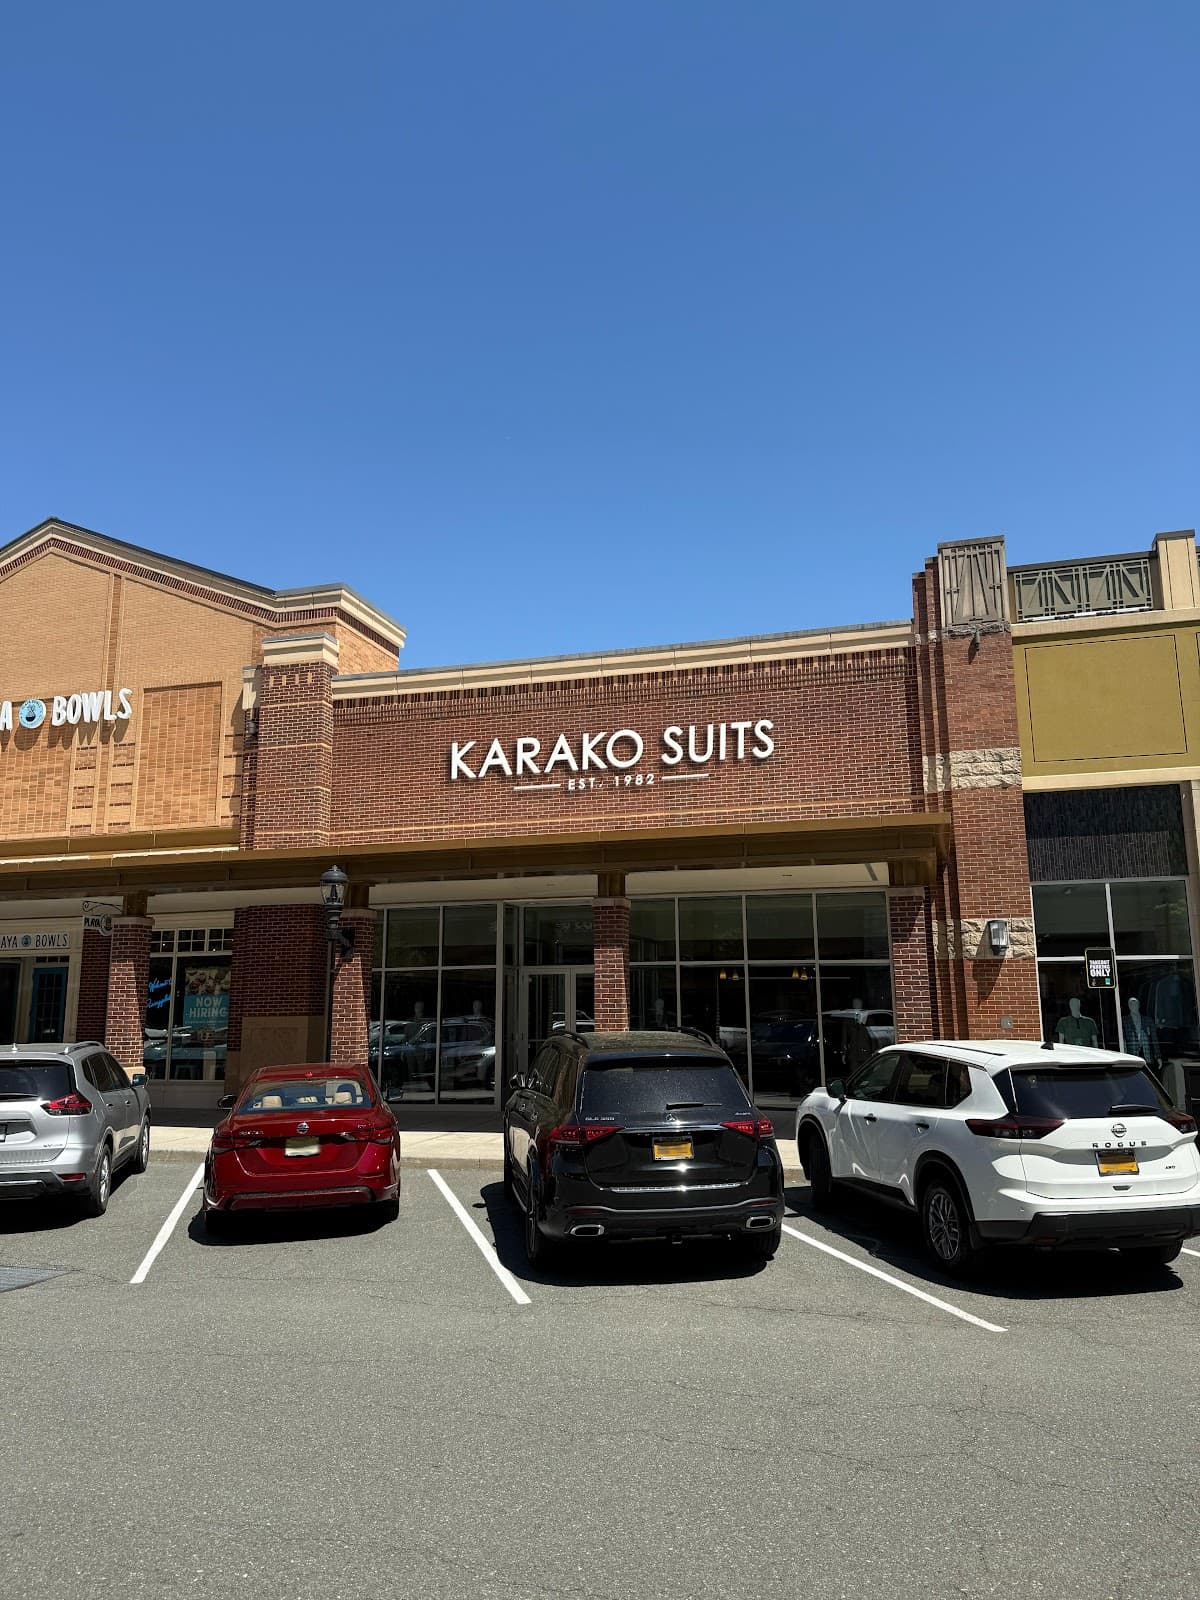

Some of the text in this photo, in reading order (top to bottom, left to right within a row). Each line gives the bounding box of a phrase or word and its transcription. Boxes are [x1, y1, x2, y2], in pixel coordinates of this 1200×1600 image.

[51, 688, 133, 726] BOWLS
[450, 719, 775, 780] KARAKO SUITS
[614, 773, 655, 787] 1982
[35, 934, 68, 947] BOWLS
[1090, 969, 1110, 977] ONLY
[195, 997, 222, 1008] NOW
[188, 1007, 227, 1018] HIRING
[1092, 1141, 1147, 1149] ROGUE
